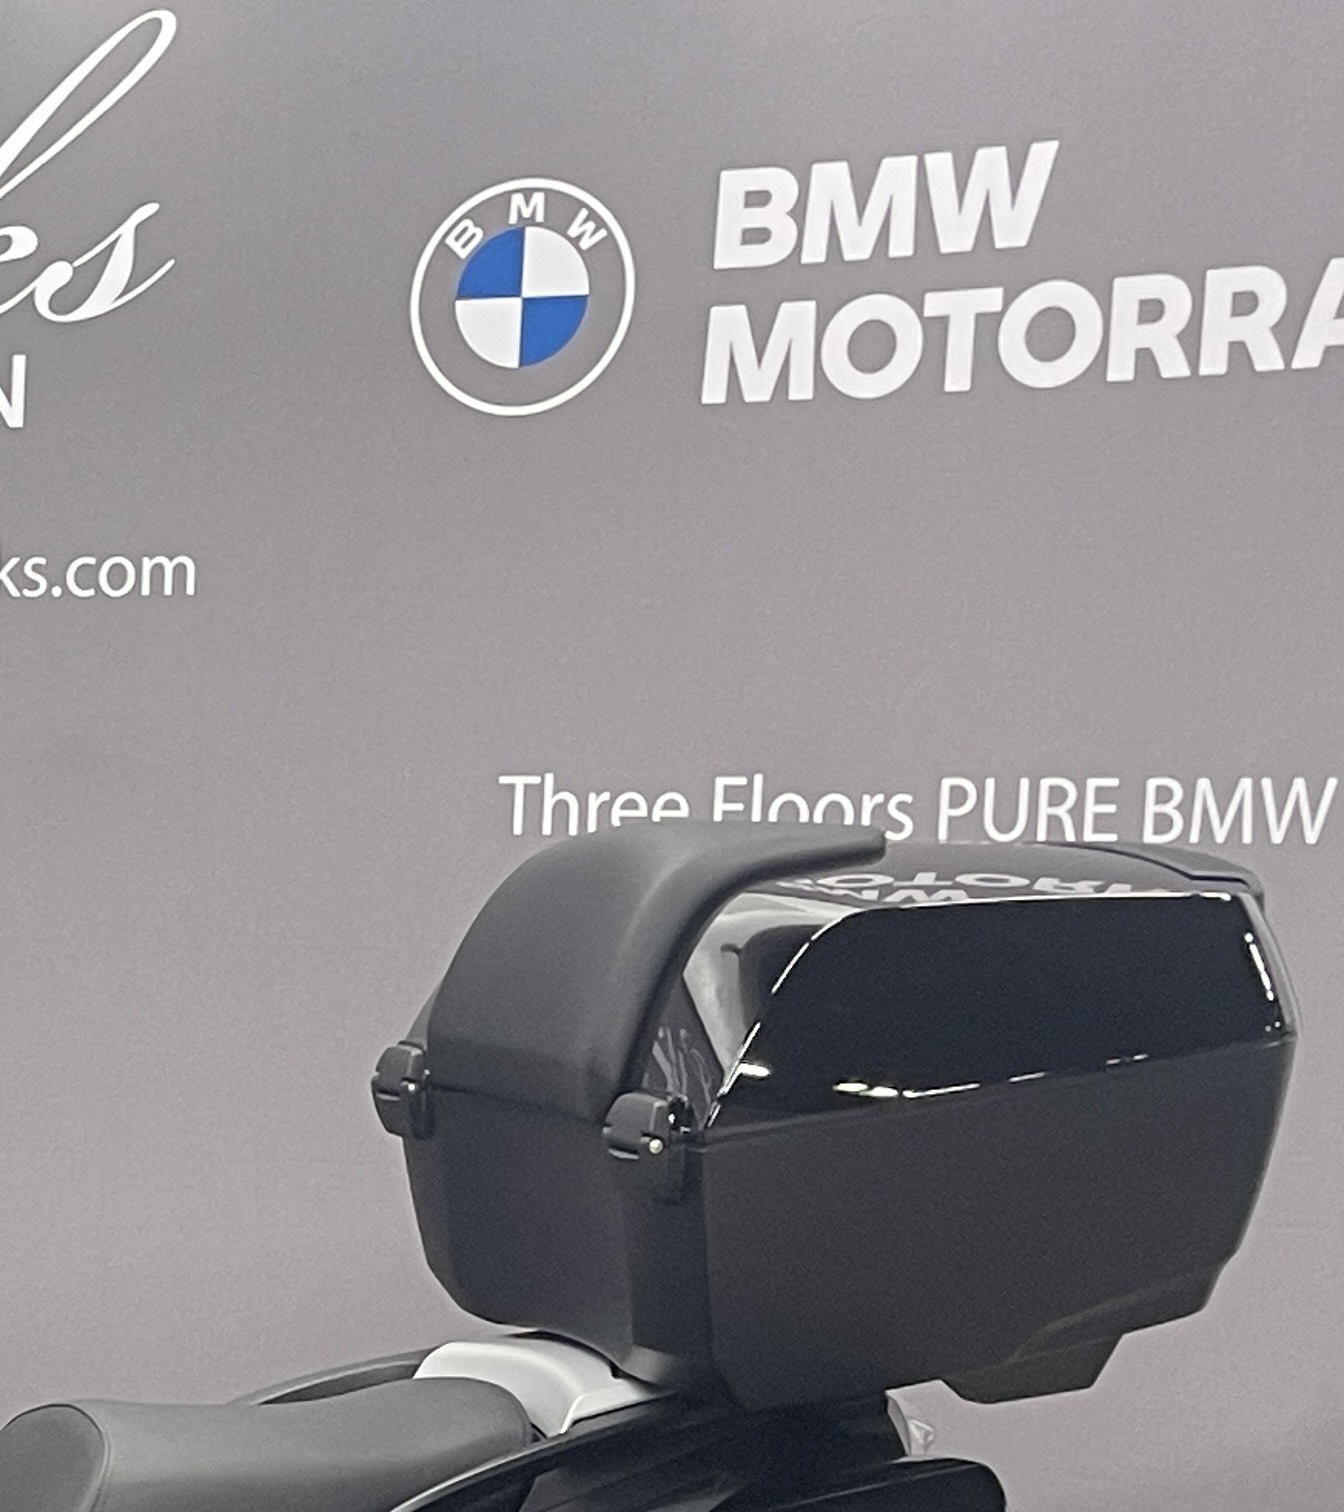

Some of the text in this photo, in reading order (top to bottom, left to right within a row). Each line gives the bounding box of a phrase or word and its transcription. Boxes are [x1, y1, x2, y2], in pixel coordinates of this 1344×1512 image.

[444, 190, 608, 261] BMW
[712, 139, 1061, 271] BMW
[700, 255, 1344, 406] MOTORRA
[497, 771, 691, 837] Three
[937, 776, 1121, 843] PURE
[1142, 776, 1340, 846] BMW
